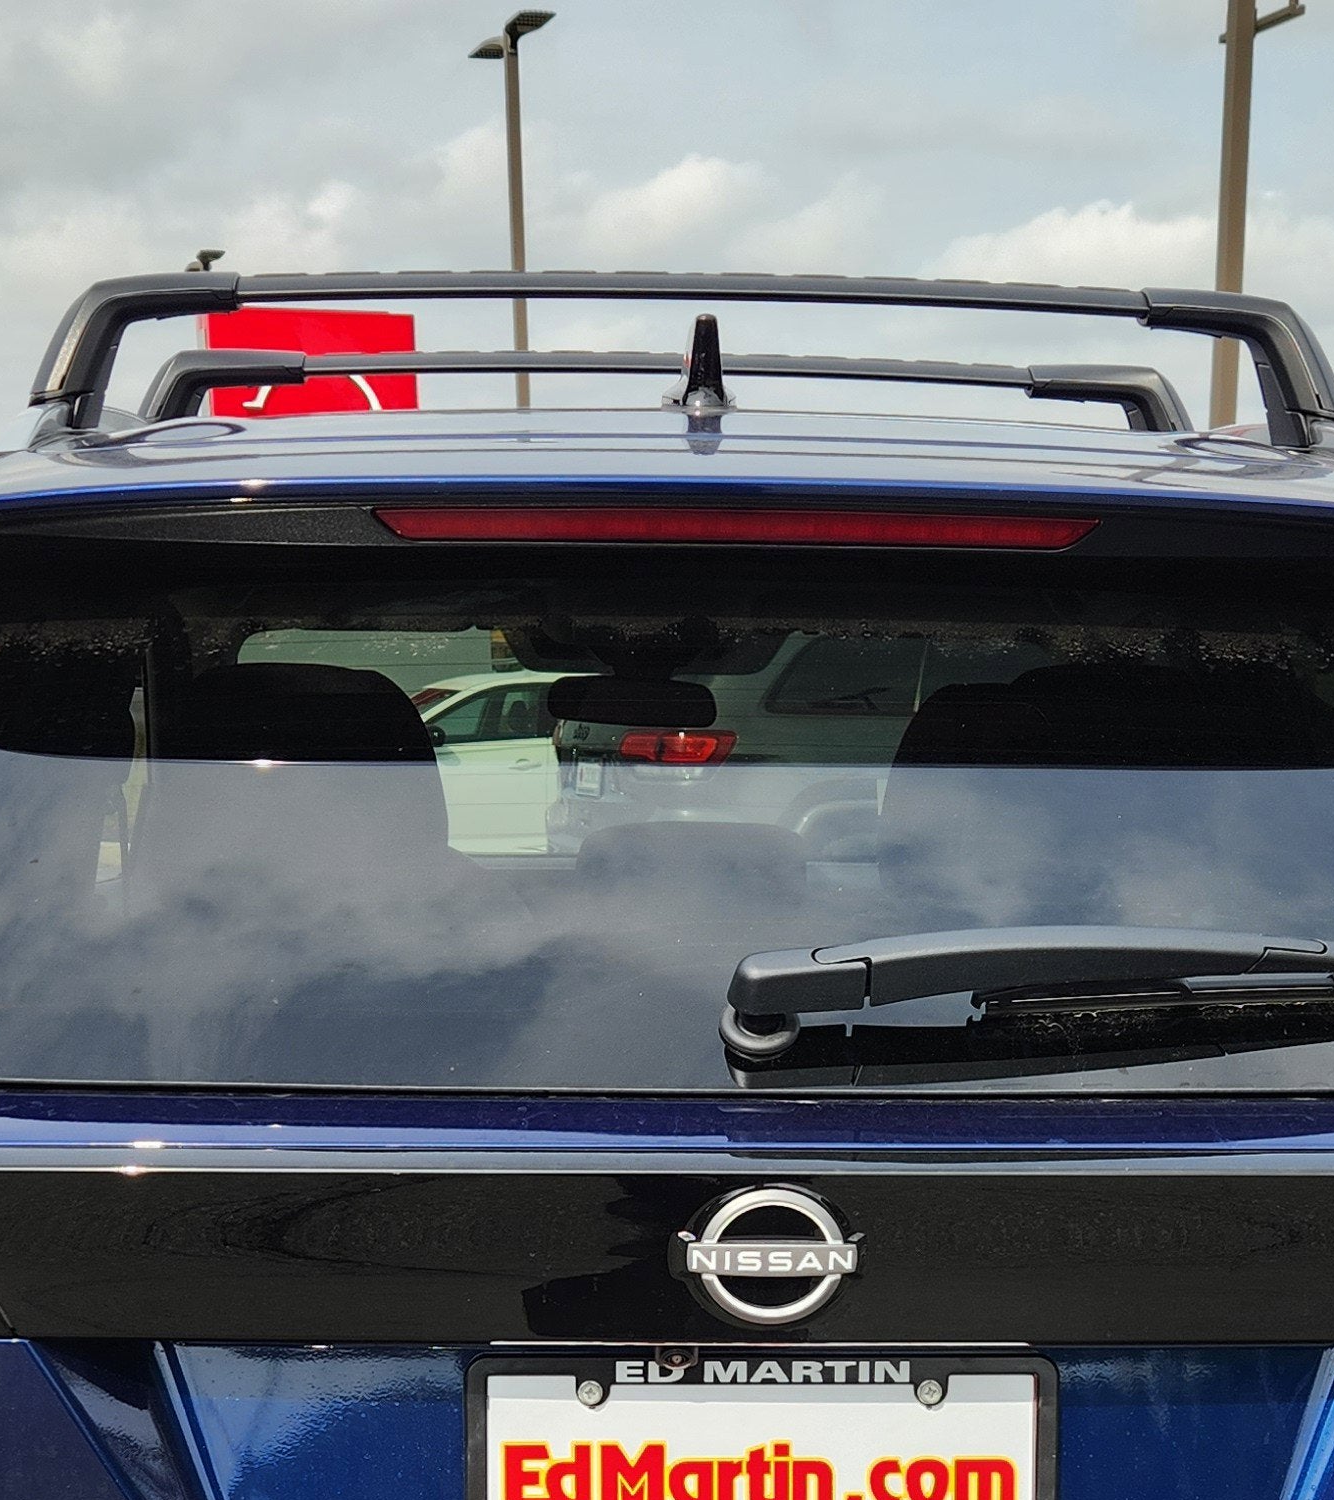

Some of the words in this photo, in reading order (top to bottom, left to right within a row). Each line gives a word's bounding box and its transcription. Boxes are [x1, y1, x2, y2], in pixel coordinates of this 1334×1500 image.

[689, 1247, 858, 1275] NISSAN
[615, 1360, 685, 1383] ED
[703, 1360, 911, 1384] MARTIN
